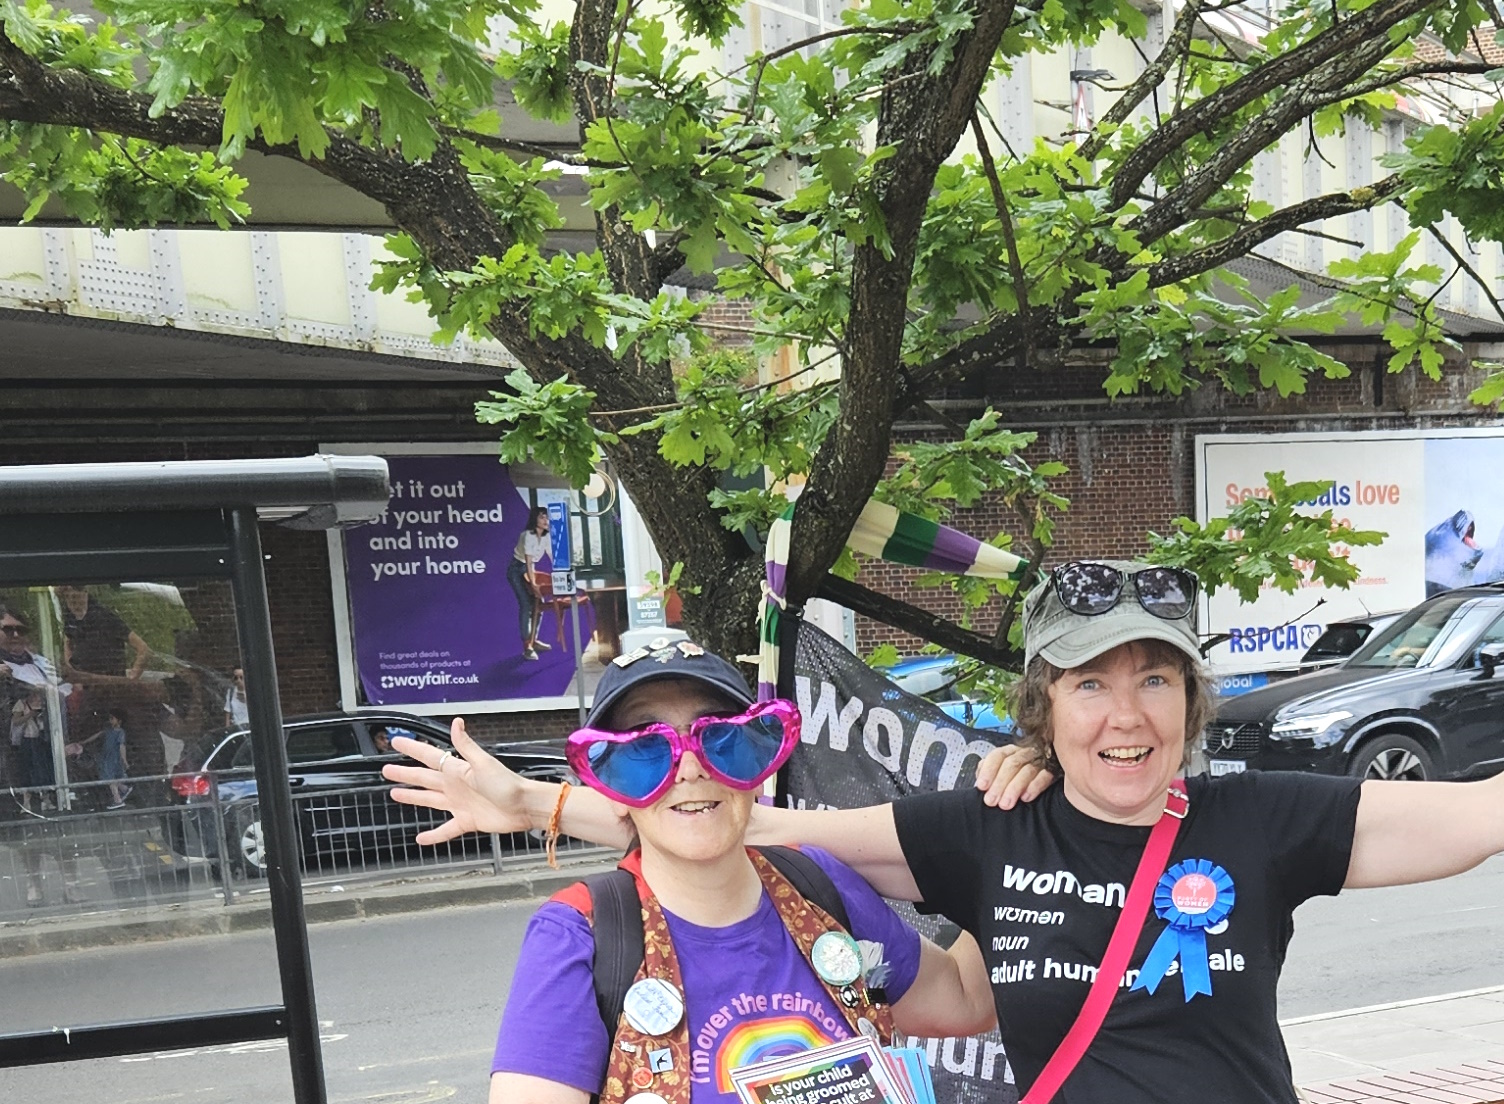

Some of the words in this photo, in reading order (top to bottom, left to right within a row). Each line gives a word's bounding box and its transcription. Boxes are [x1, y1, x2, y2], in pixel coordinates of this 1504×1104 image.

[409, 479, 424, 498] it
[430, 480, 465, 498] out
[1356, 480, 1400, 506] love
[394, 510, 443, 529] your
[447, 503, 503, 523] head
[369, 530, 412, 550] and
[417, 531, 459, 549] into
[371, 561, 420, 581] your
[425, 556, 486, 574] home
[1229, 625, 1298, 653] RSPCA
[1002, 864, 1126, 909] woman
[992, 935, 1029, 951] noun
[991, 959, 1036, 984] adult
[1043, 958, 1140, 988] humn
[696, 1006, 733, 1050] over
[731, 992, 768, 1016] the
[771, 992, 852, 1042] rainbow
[782, 1076, 816, 1096] your
[817, 1063, 852, 1084] child
[806, 1073, 871, 1104] groomed
[858, 1088, 876, 1101] at
